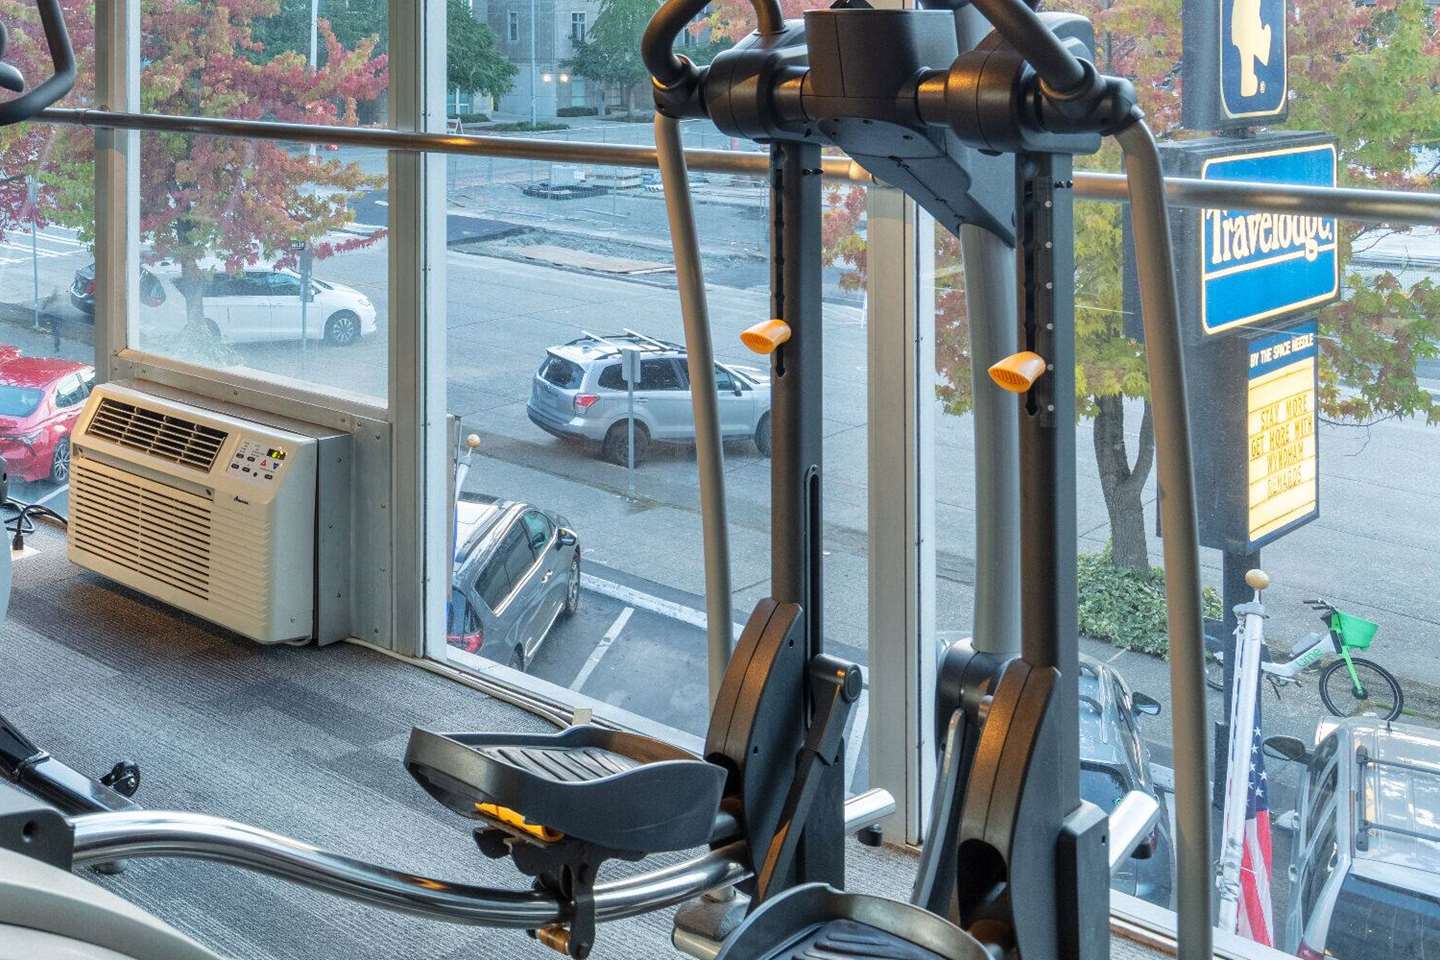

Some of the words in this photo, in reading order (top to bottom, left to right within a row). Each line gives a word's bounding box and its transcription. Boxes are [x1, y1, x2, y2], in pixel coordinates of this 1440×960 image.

[1260, 347, 1273, 364] THE
[1286, 395, 1307, 419] MORE
[1269, 426, 1289, 450] MORE
